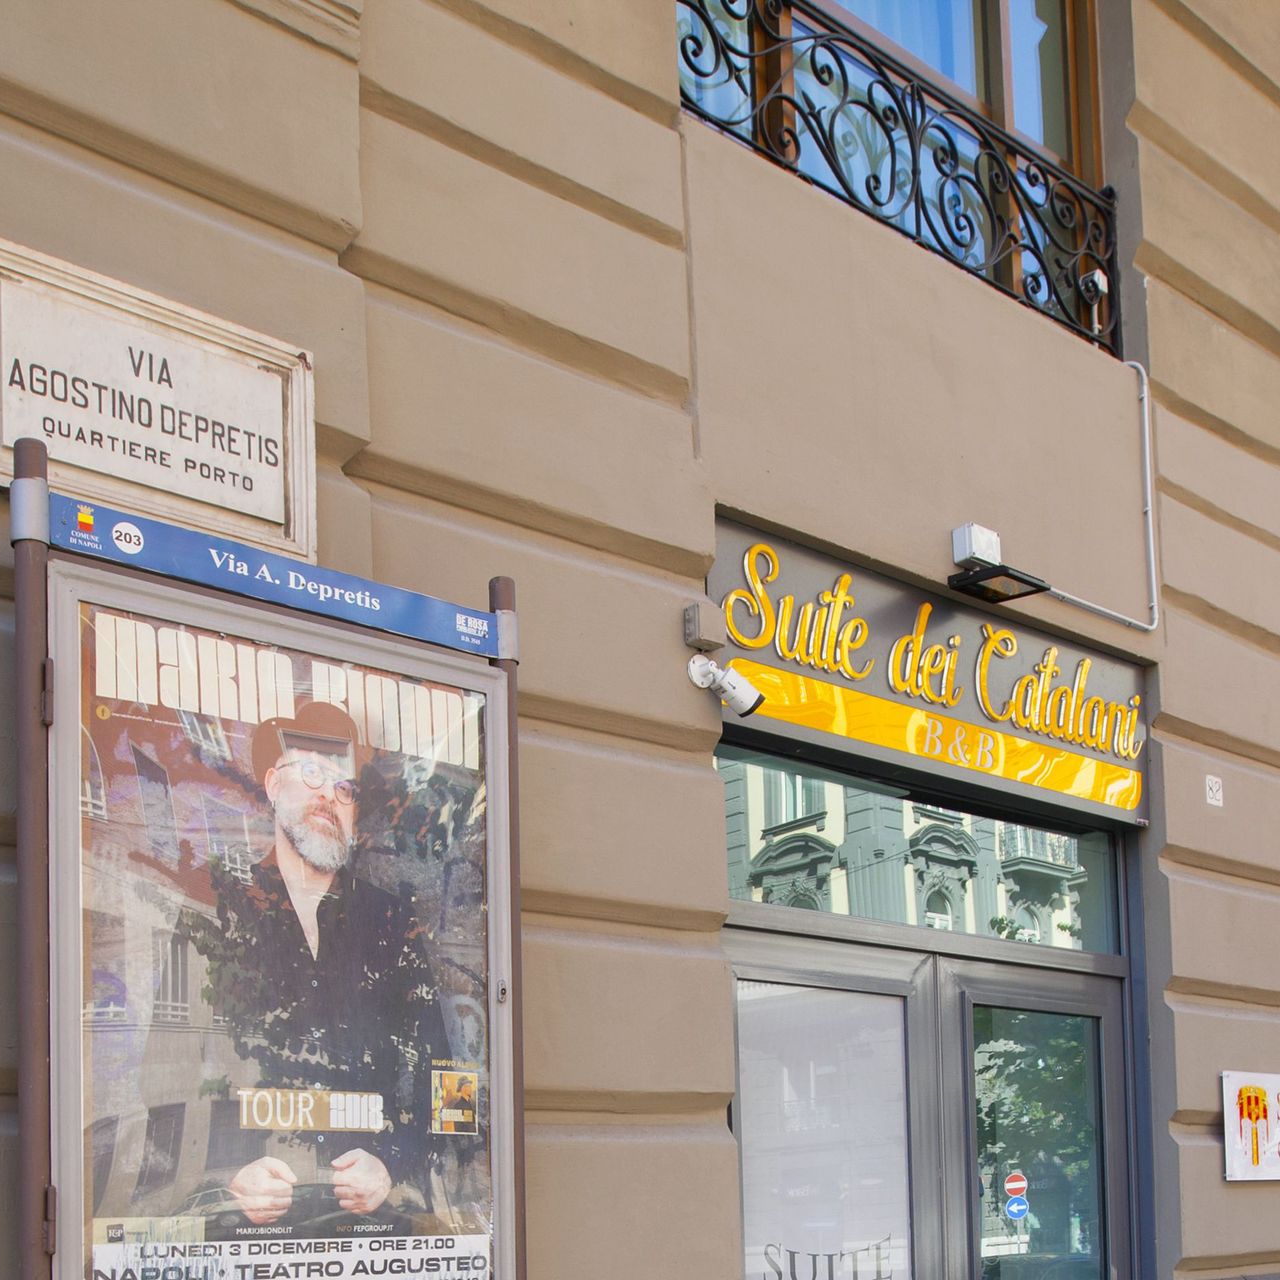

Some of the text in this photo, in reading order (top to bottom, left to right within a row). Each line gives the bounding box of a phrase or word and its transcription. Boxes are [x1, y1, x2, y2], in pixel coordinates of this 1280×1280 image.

[128, 346, 173, 388] VIA
[9, 357, 279, 467] AGOSTINO DEPRETIS
[42, 416, 253, 491] QUARTIERE PORTO
[71, 530, 100, 542] COMUNE
[78, 539, 102, 551] NAPOLI
[114, 530, 141, 546] 203
[208, 547, 381, 612] Via A. Depretis
[721, 543, 1143, 761] Suite dei Catalani
[923, 718, 994, 769] B & B
[237, 1090, 384, 1129] TOUR 2018
[229, 1243, 241, 1257] 3
[248, 1241, 352, 1256] DICEMBRE
[369, 1239, 408, 1252] ORE
[411, 1238, 455, 1250] 21.00
[236, 1261, 345, 1280] TEATRO
[351, 1255, 487, 1276] AUGUSTEO
